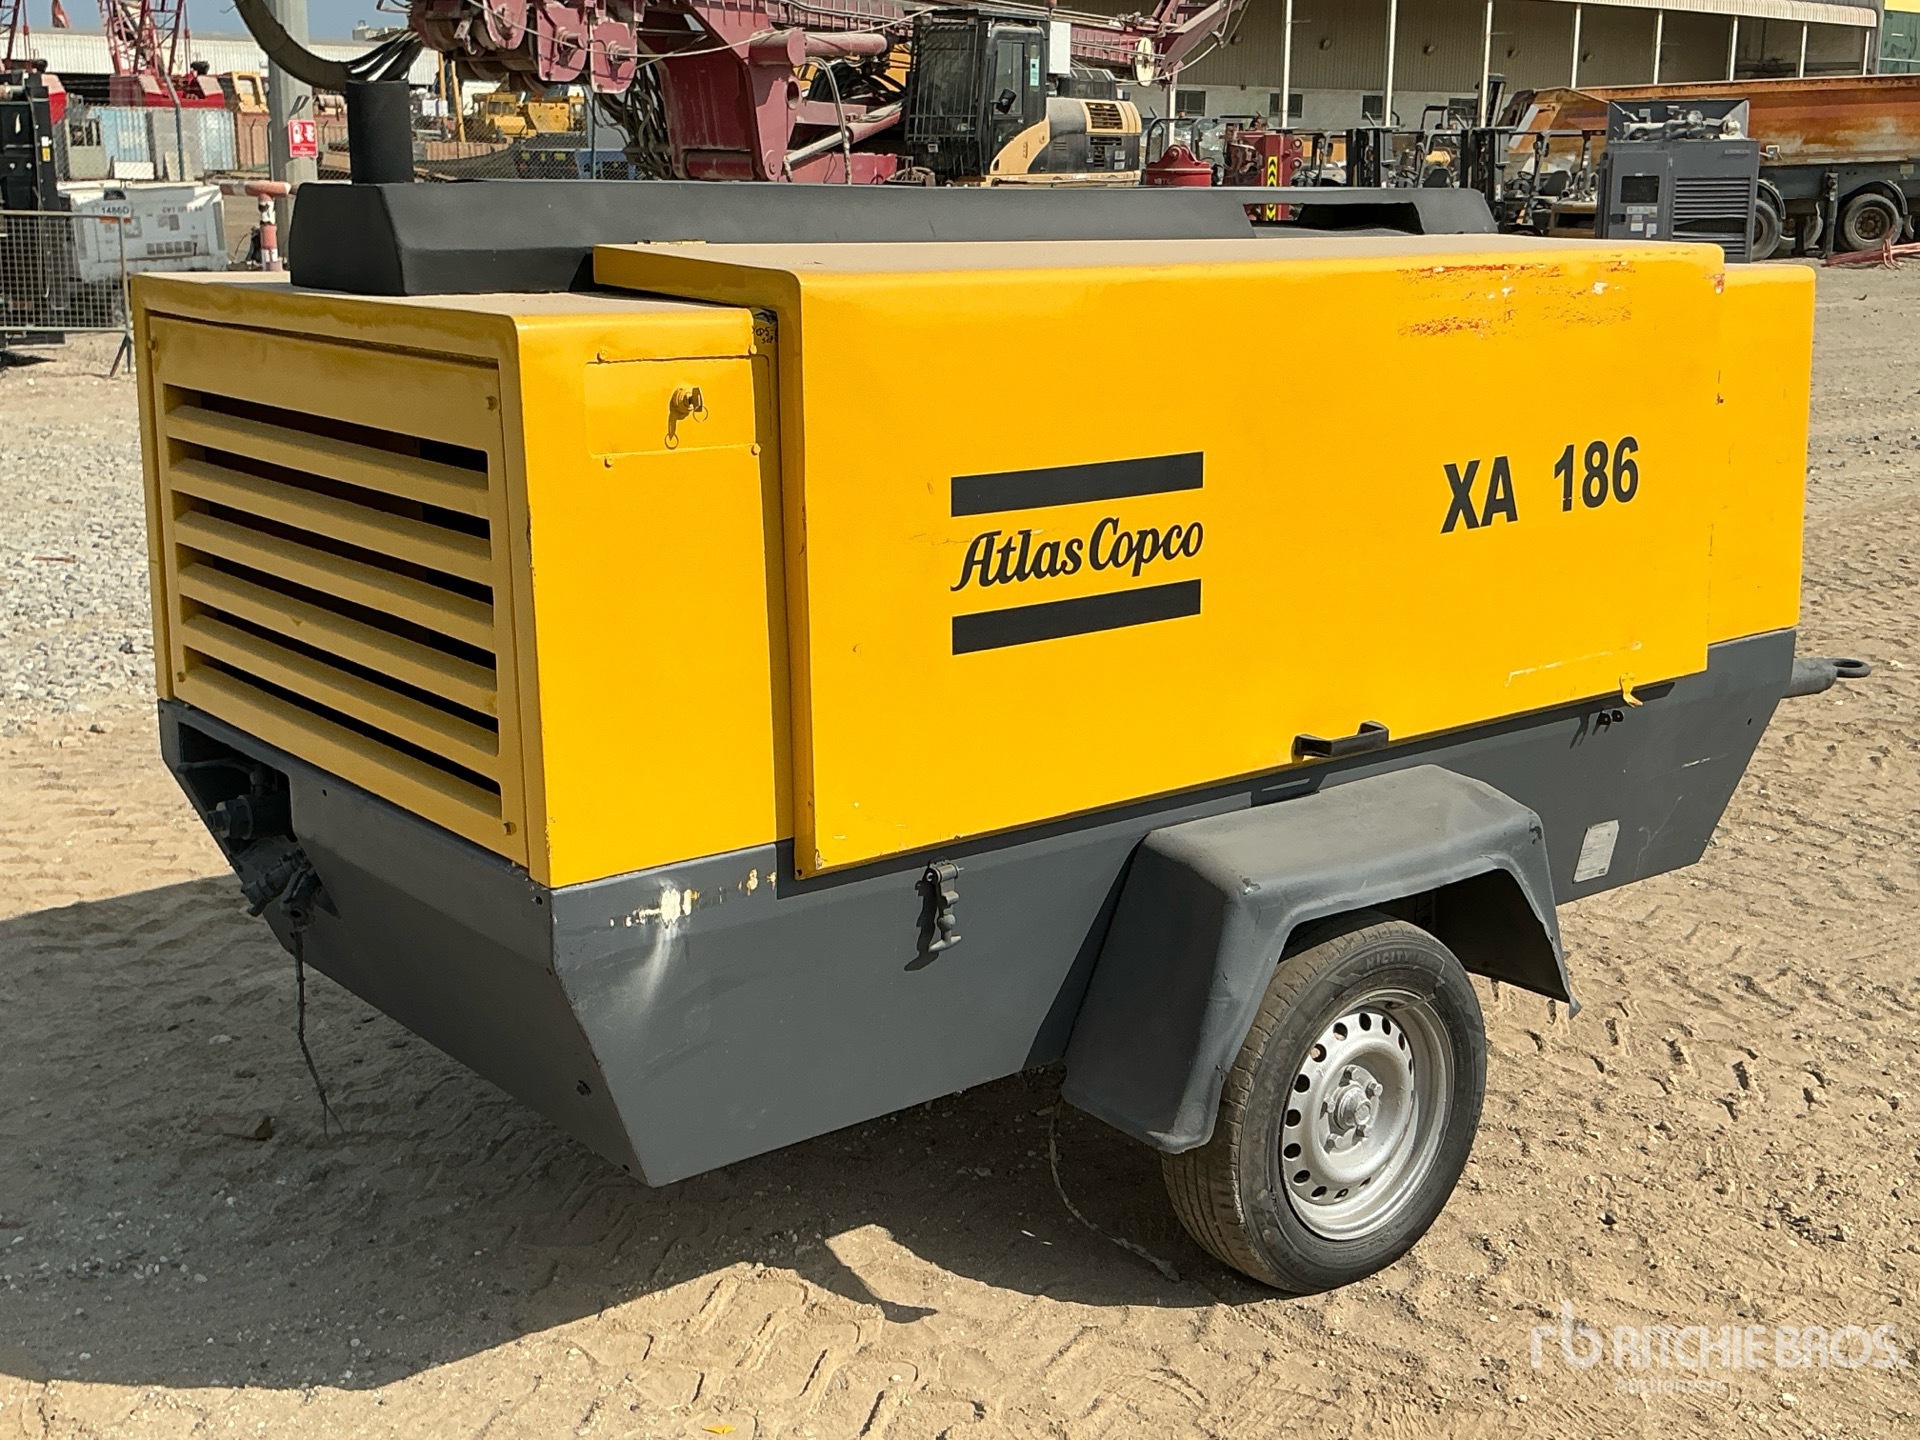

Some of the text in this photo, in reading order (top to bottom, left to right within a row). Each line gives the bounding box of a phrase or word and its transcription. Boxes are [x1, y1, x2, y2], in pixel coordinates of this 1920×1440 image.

[1440, 436, 1639, 534] XA 186
[950, 517, 1204, 592] Atlas Copco
